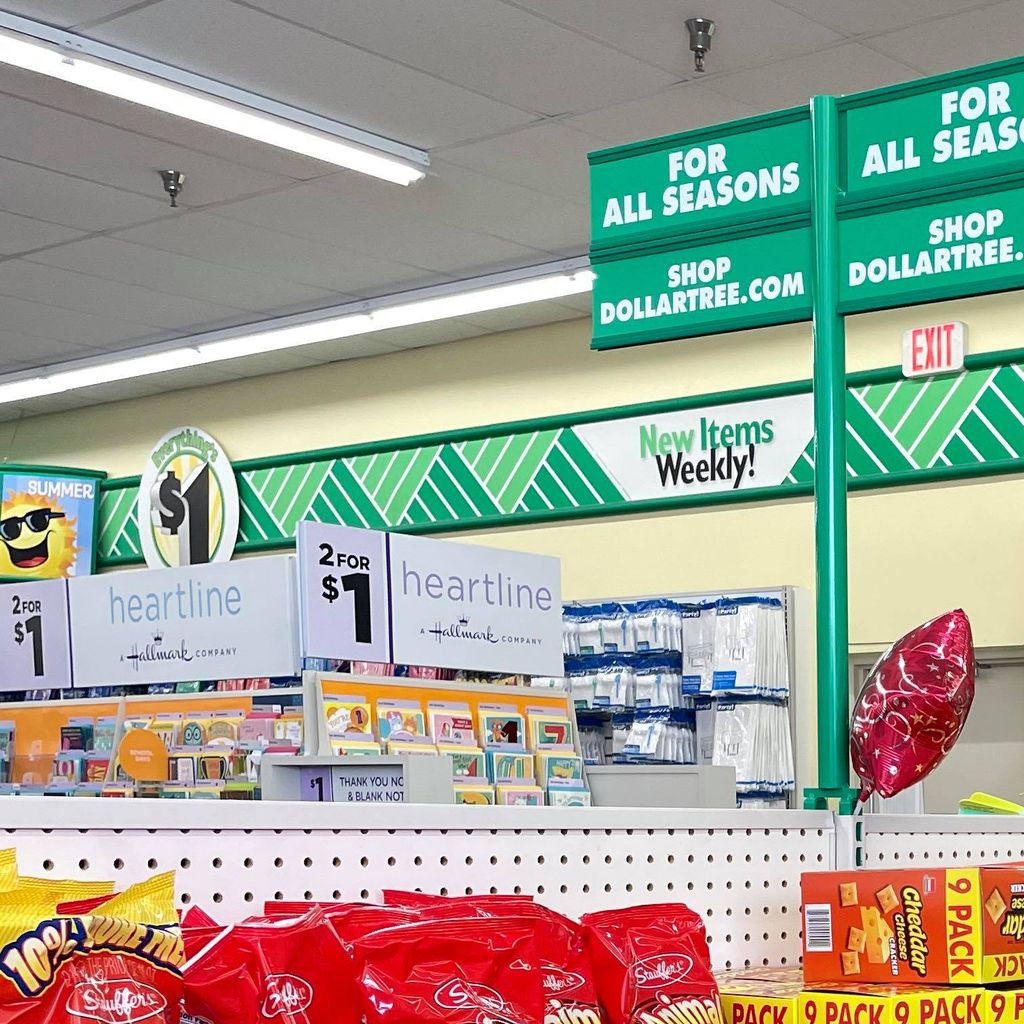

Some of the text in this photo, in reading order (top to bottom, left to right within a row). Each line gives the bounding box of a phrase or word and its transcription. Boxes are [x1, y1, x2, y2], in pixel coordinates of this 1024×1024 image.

[941, 82, 1011, 125] FOR
[668, 143, 727, 182] FOR
[861, 137, 920, 178] ALL
[603, 162, 800, 229] ALL SEASONS
[928, 209, 1003, 245] SHOP
[668, 257, 731, 288] SHOP
[600, 272, 804, 325] DOLLARTREE.COM
[912, 324, 953, 372] EXIT
[639, 417, 774, 459] New Items
[655, 443, 755, 489] Weekly!
[28, 480, 94, 499] SUMMER
[319, 543, 370, 570] 2 FOR
[12, 596, 41, 614] 2 FOR
[110, 579, 241, 624] heartline
[402, 561, 551, 611] heartline
[322, 572, 372, 644] $1
[15, 616, 44, 676] $1
[429, 622, 499, 644] Hallmark
[502, 636, 541, 645] COMPANY
[127, 640, 194, 671] Hallmark
[196, 648, 236, 658] COMPANY
[310, 777, 323, 801] $1
[340, 777, 367, 786] THANK
[370, 777, 388, 786] YOU
[348, 792, 353, 801] &
[356, 792, 383, 801] BLANK
[894, 914, 908, 960] Cheese
[901, 886, 927, 977] Cheddar
[888, 937, 898, 975] CRACKER
[991, 995, 1005, 1021] 9
